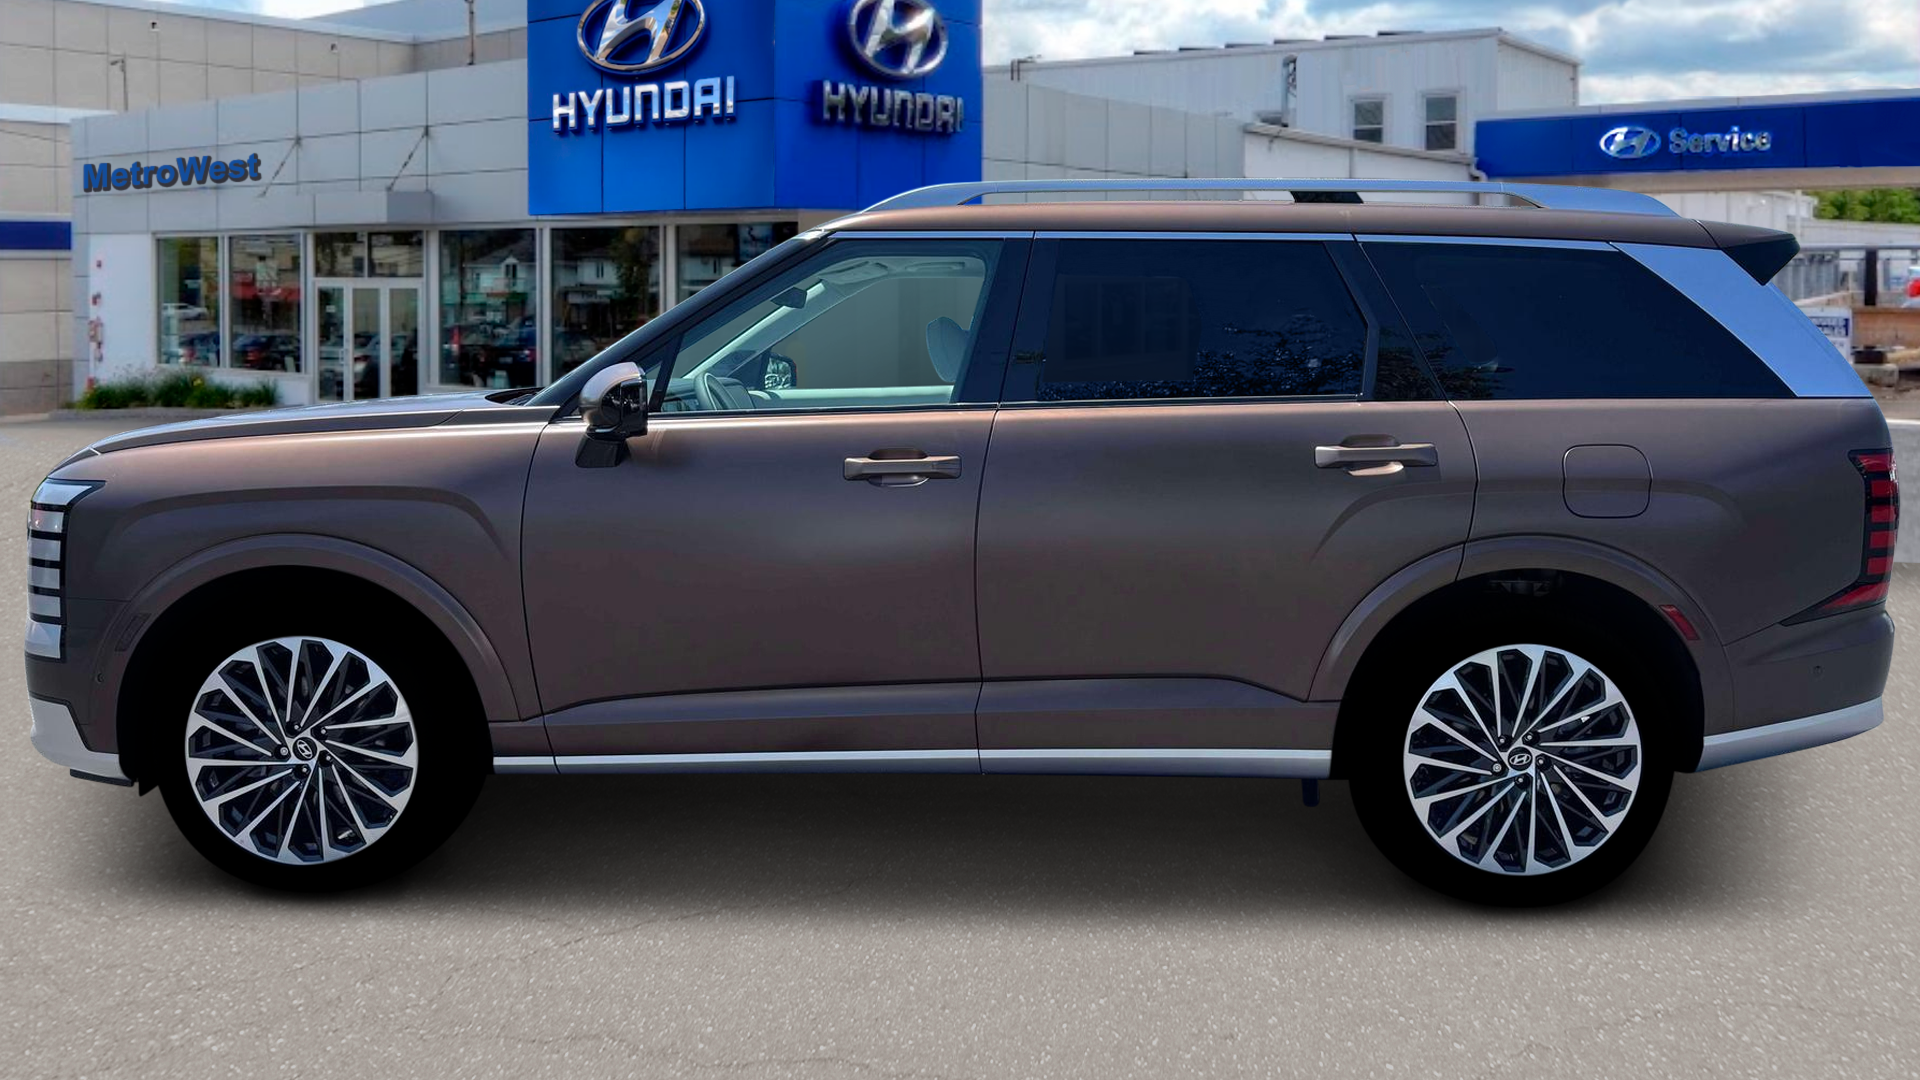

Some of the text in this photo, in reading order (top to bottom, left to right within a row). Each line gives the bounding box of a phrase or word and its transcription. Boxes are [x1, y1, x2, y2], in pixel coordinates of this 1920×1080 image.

[552, 76, 735, 132] HYUNDAI
[823, 80, 964, 133] HYUNDAI
[1669, 126, 1772, 154] Service
[83, 153, 261, 192] MetroWest
